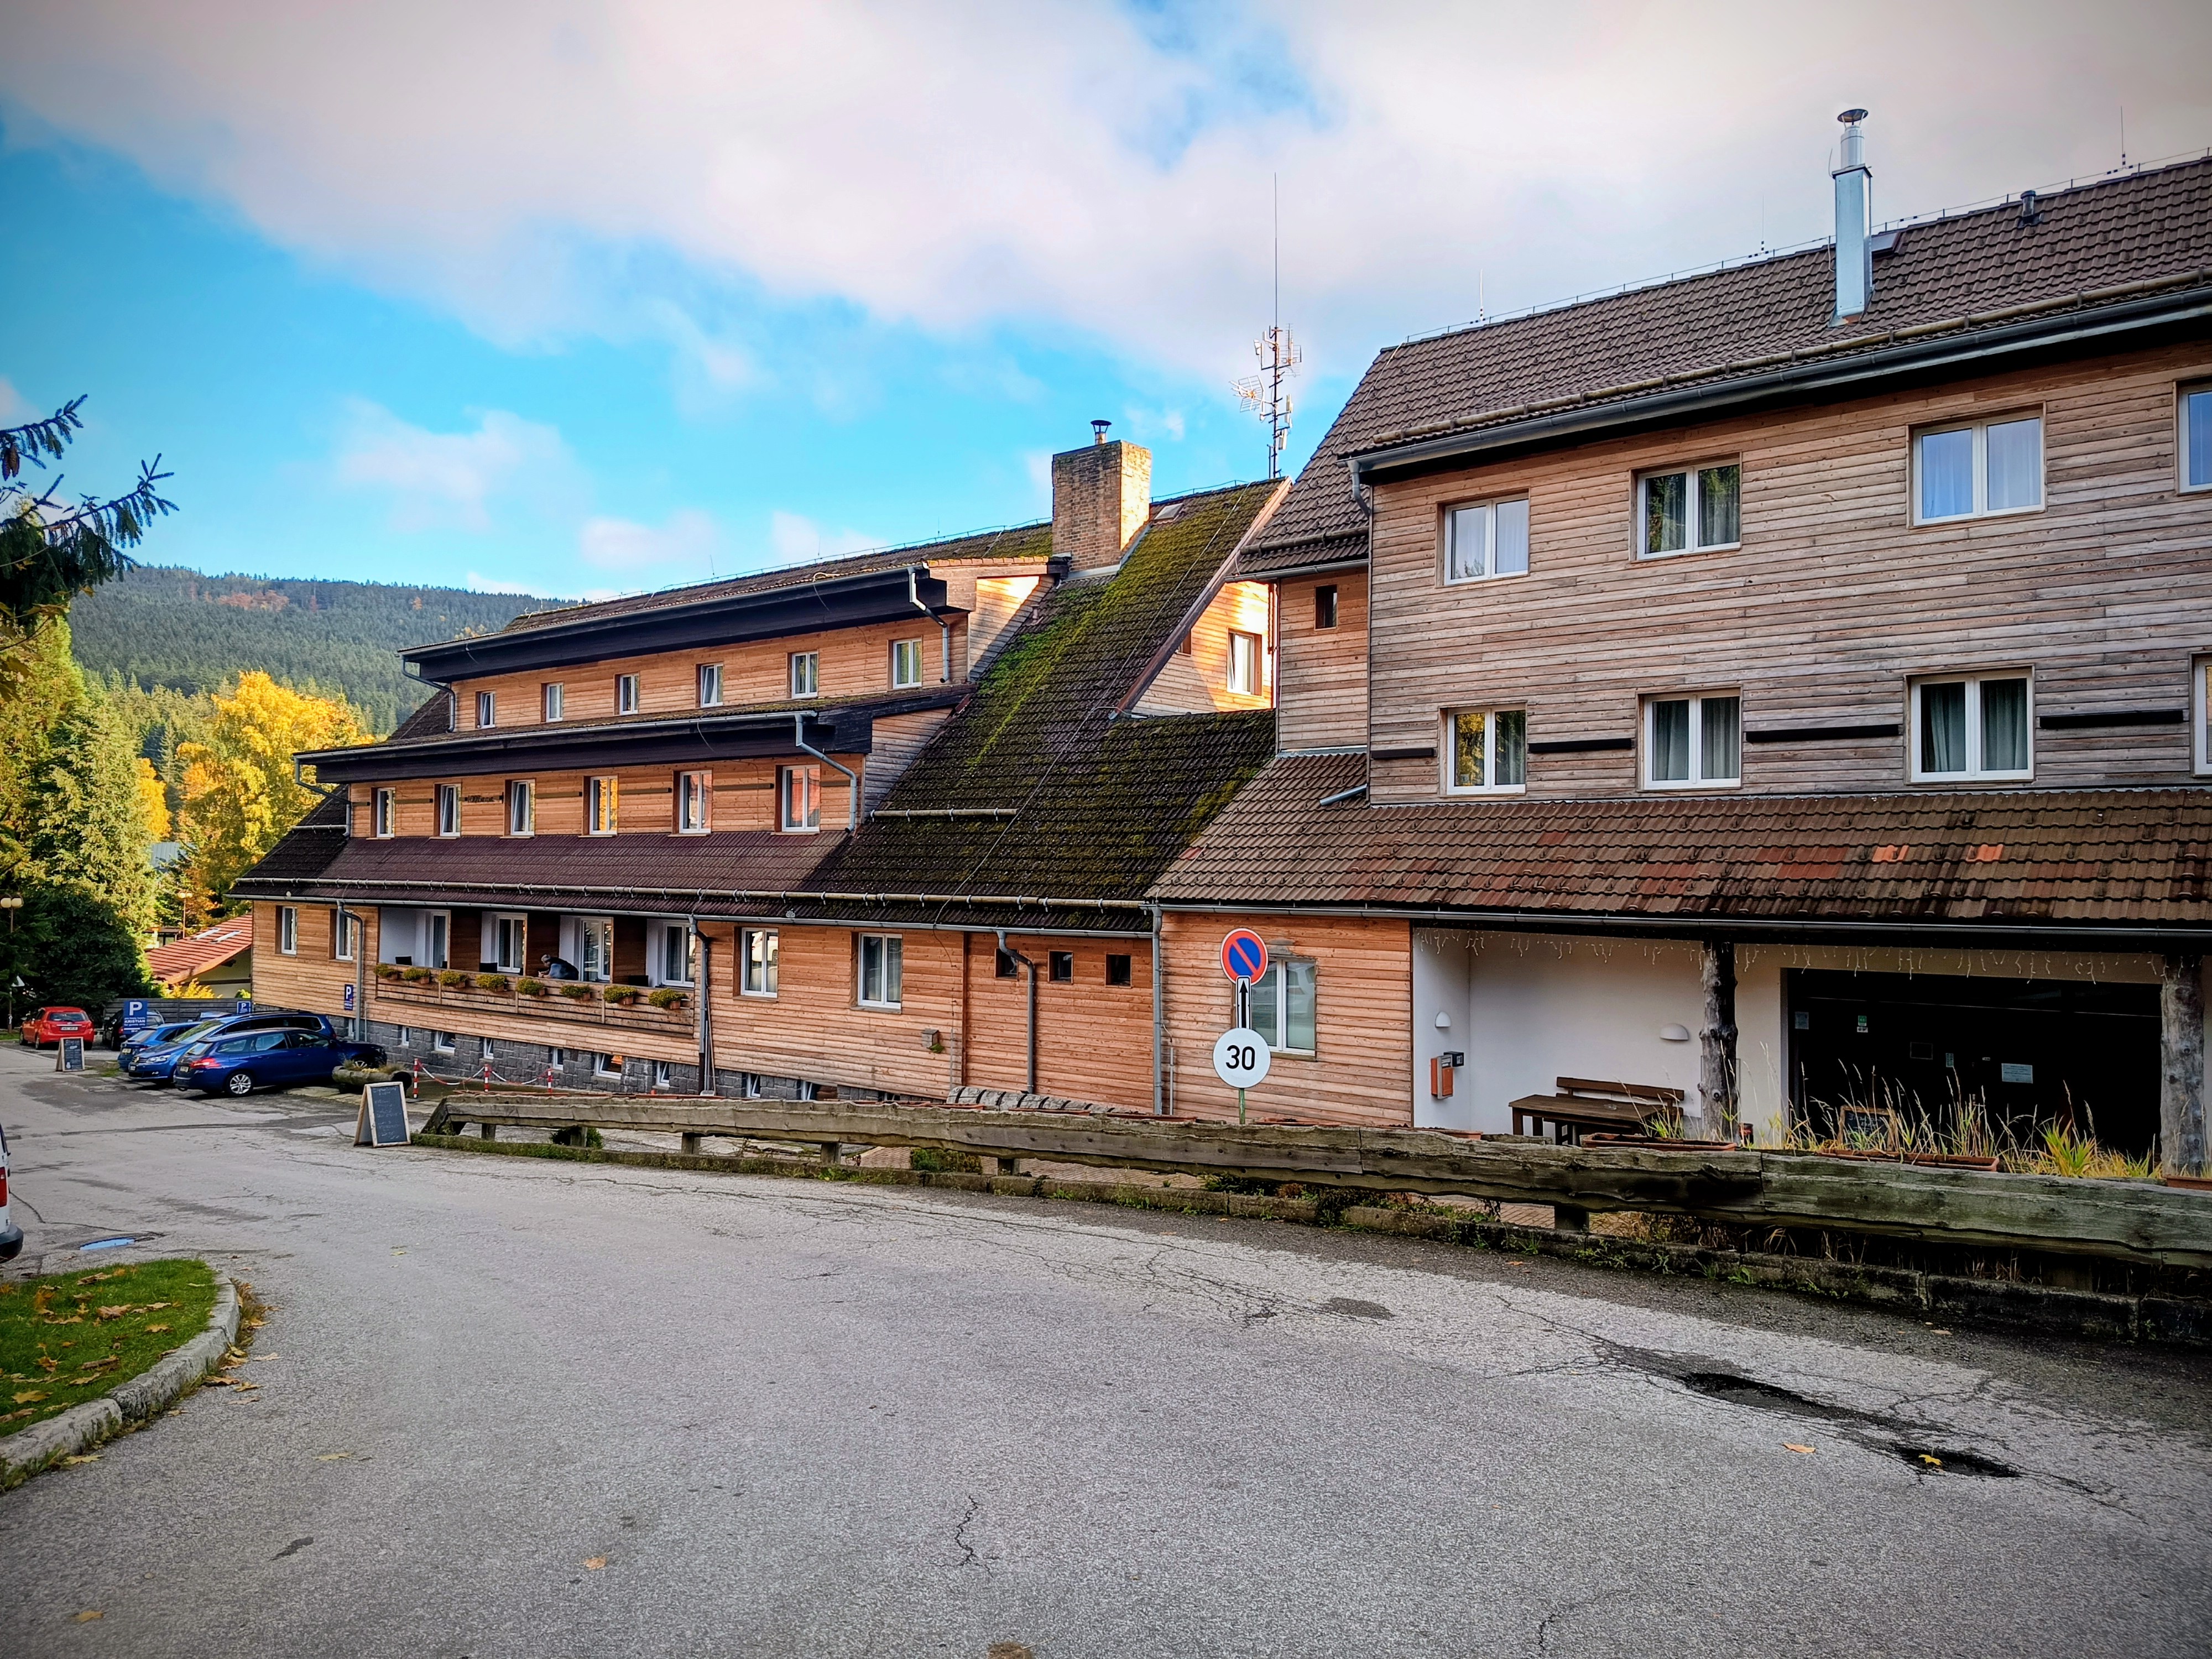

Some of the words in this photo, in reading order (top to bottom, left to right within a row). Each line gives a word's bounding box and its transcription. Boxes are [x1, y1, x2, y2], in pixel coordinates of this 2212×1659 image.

[346, 986, 352, 999] P
[129, 1001, 143, 1016] P
[1225, 1045, 1255, 1071] 30
